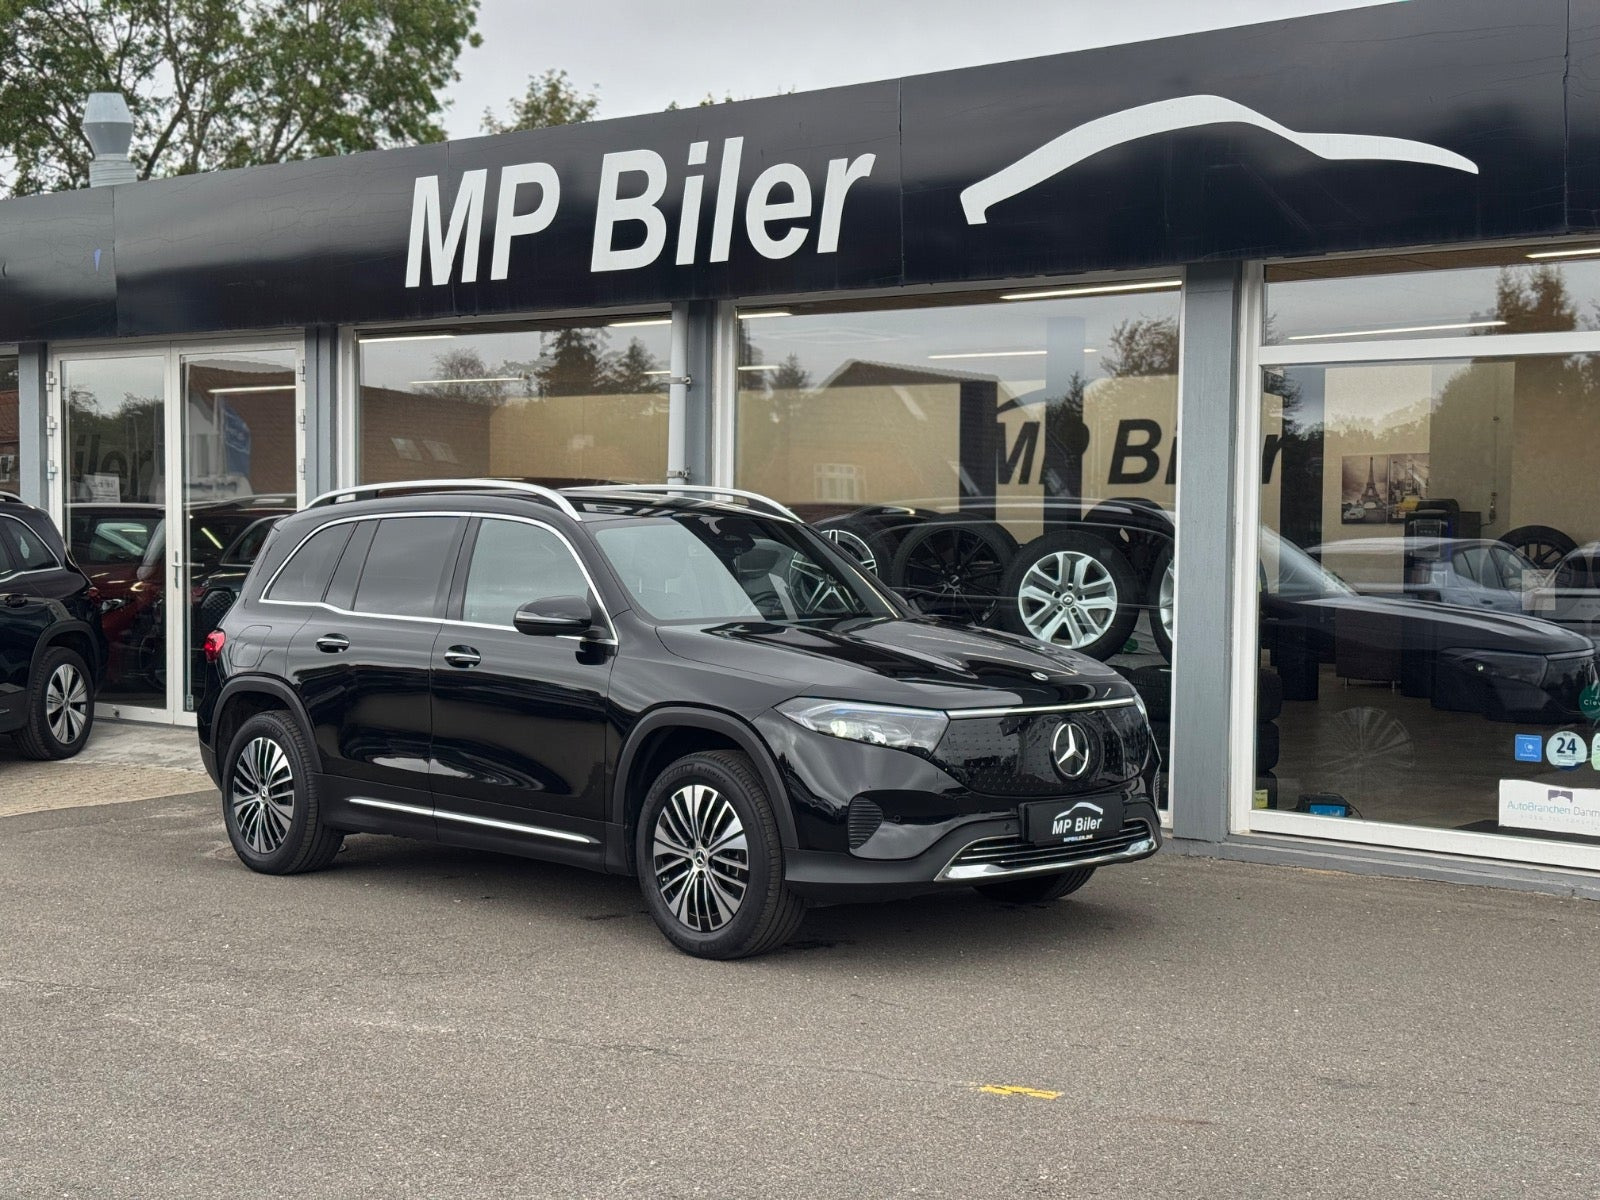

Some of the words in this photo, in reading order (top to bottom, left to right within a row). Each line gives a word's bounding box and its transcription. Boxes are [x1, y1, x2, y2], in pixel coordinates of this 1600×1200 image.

[405, 162, 561, 288] MP
[590, 136, 877, 273] Biler
[1556, 737, 1577, 754] 24
[1507, 800, 1571, 815] AutoBranchen
[1052, 819, 1072, 835] MP
[1074, 816, 1103, 832] Biler
